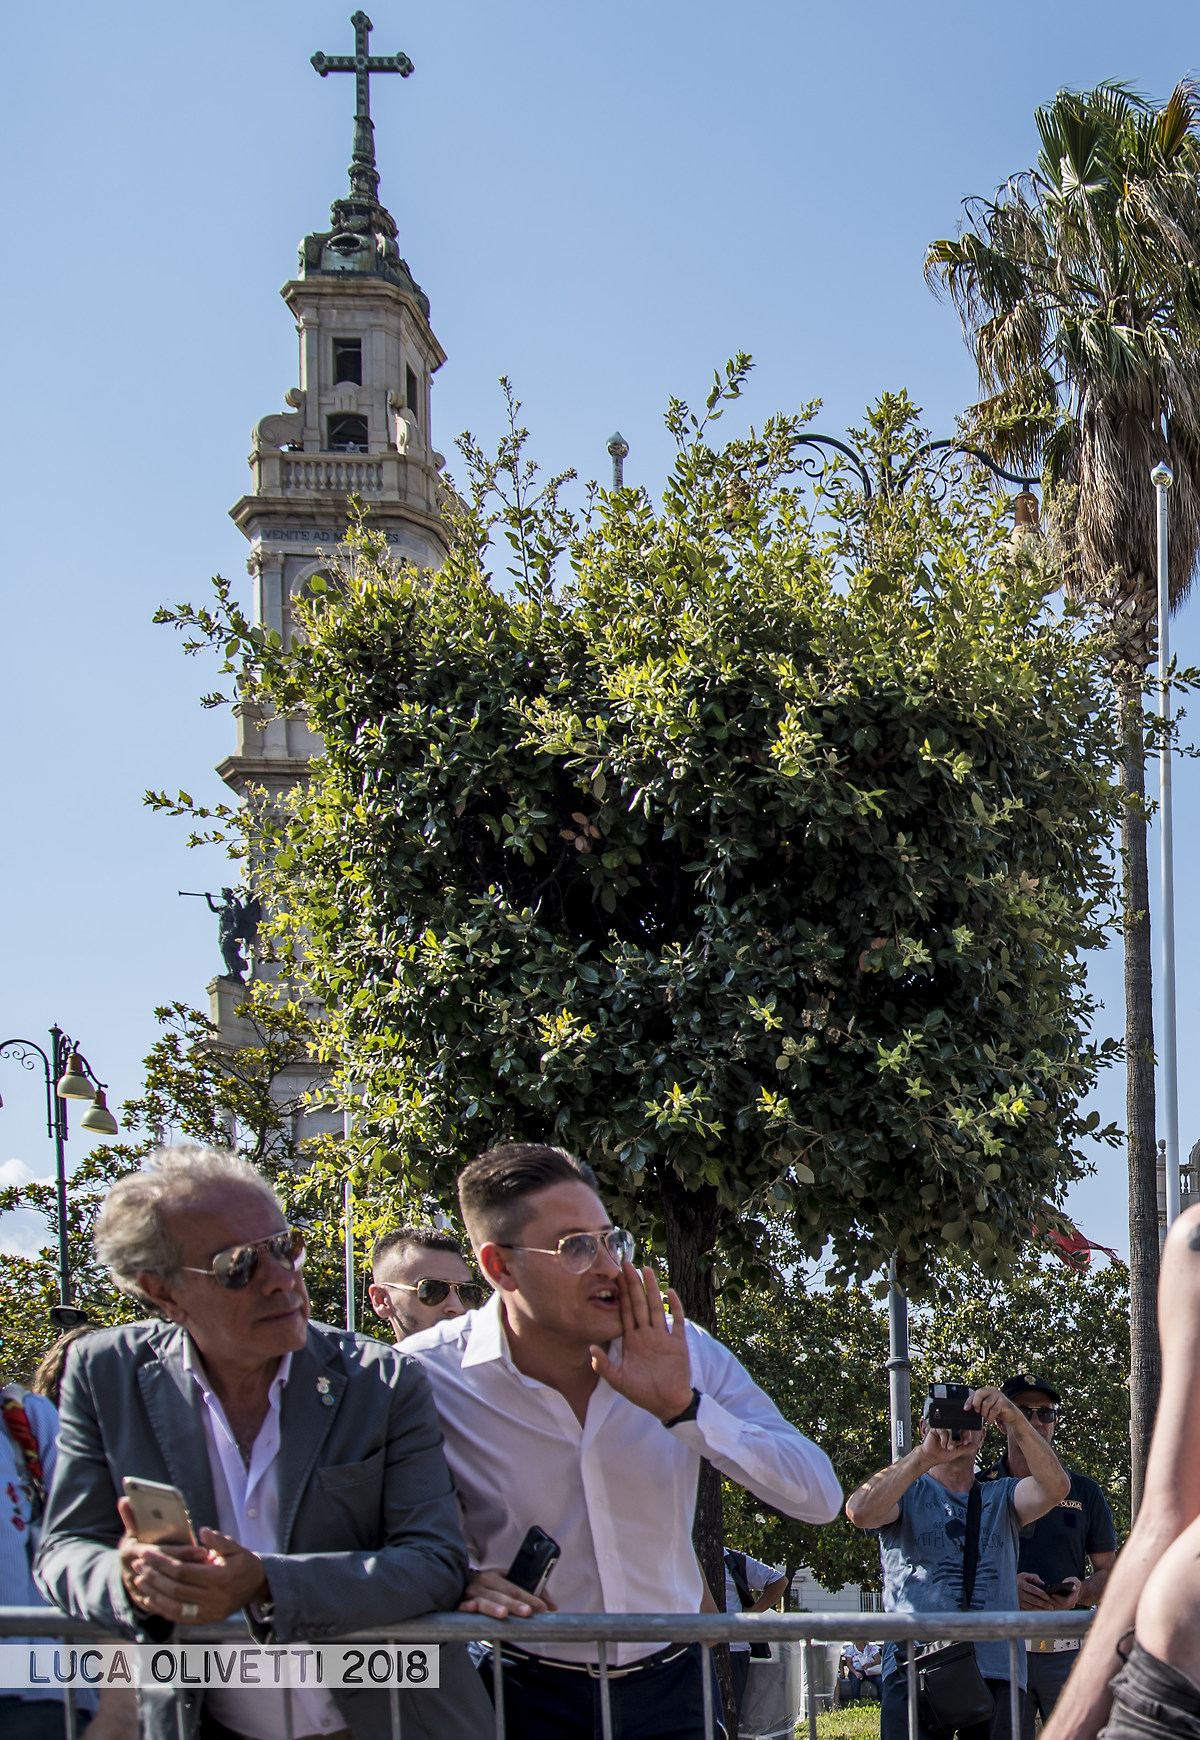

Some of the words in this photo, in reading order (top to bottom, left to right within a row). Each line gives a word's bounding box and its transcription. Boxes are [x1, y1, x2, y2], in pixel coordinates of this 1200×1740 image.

[263, 529, 310, 541] VENITE
[313, 531, 331, 542] AD
[1058, 1500, 1082, 1511] OLIZIA
